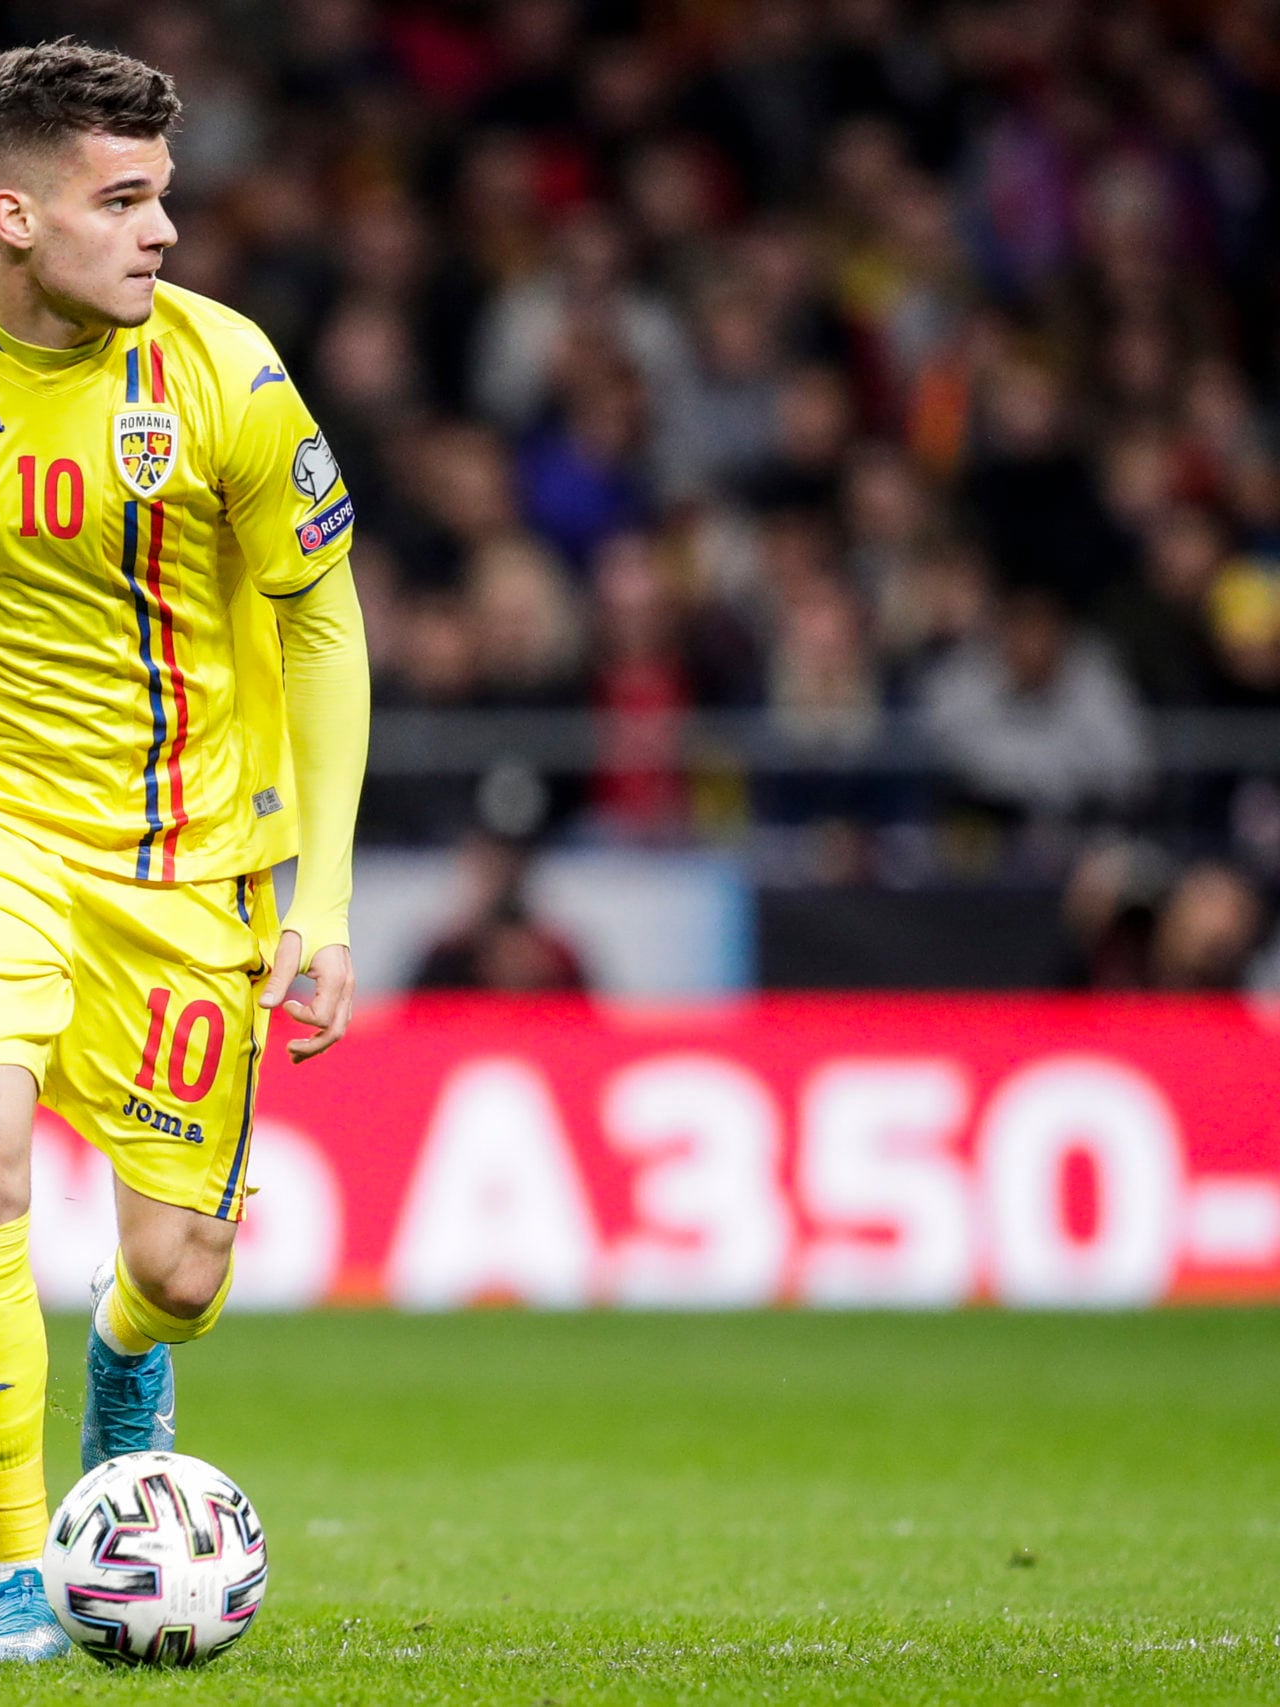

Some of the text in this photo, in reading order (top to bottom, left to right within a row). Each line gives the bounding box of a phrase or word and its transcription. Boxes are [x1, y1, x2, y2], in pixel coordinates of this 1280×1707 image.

[17, 455, 84, 540] 10
[135, 987, 225, 1103] 10
[123, 1094, 205, 1144] Joma
